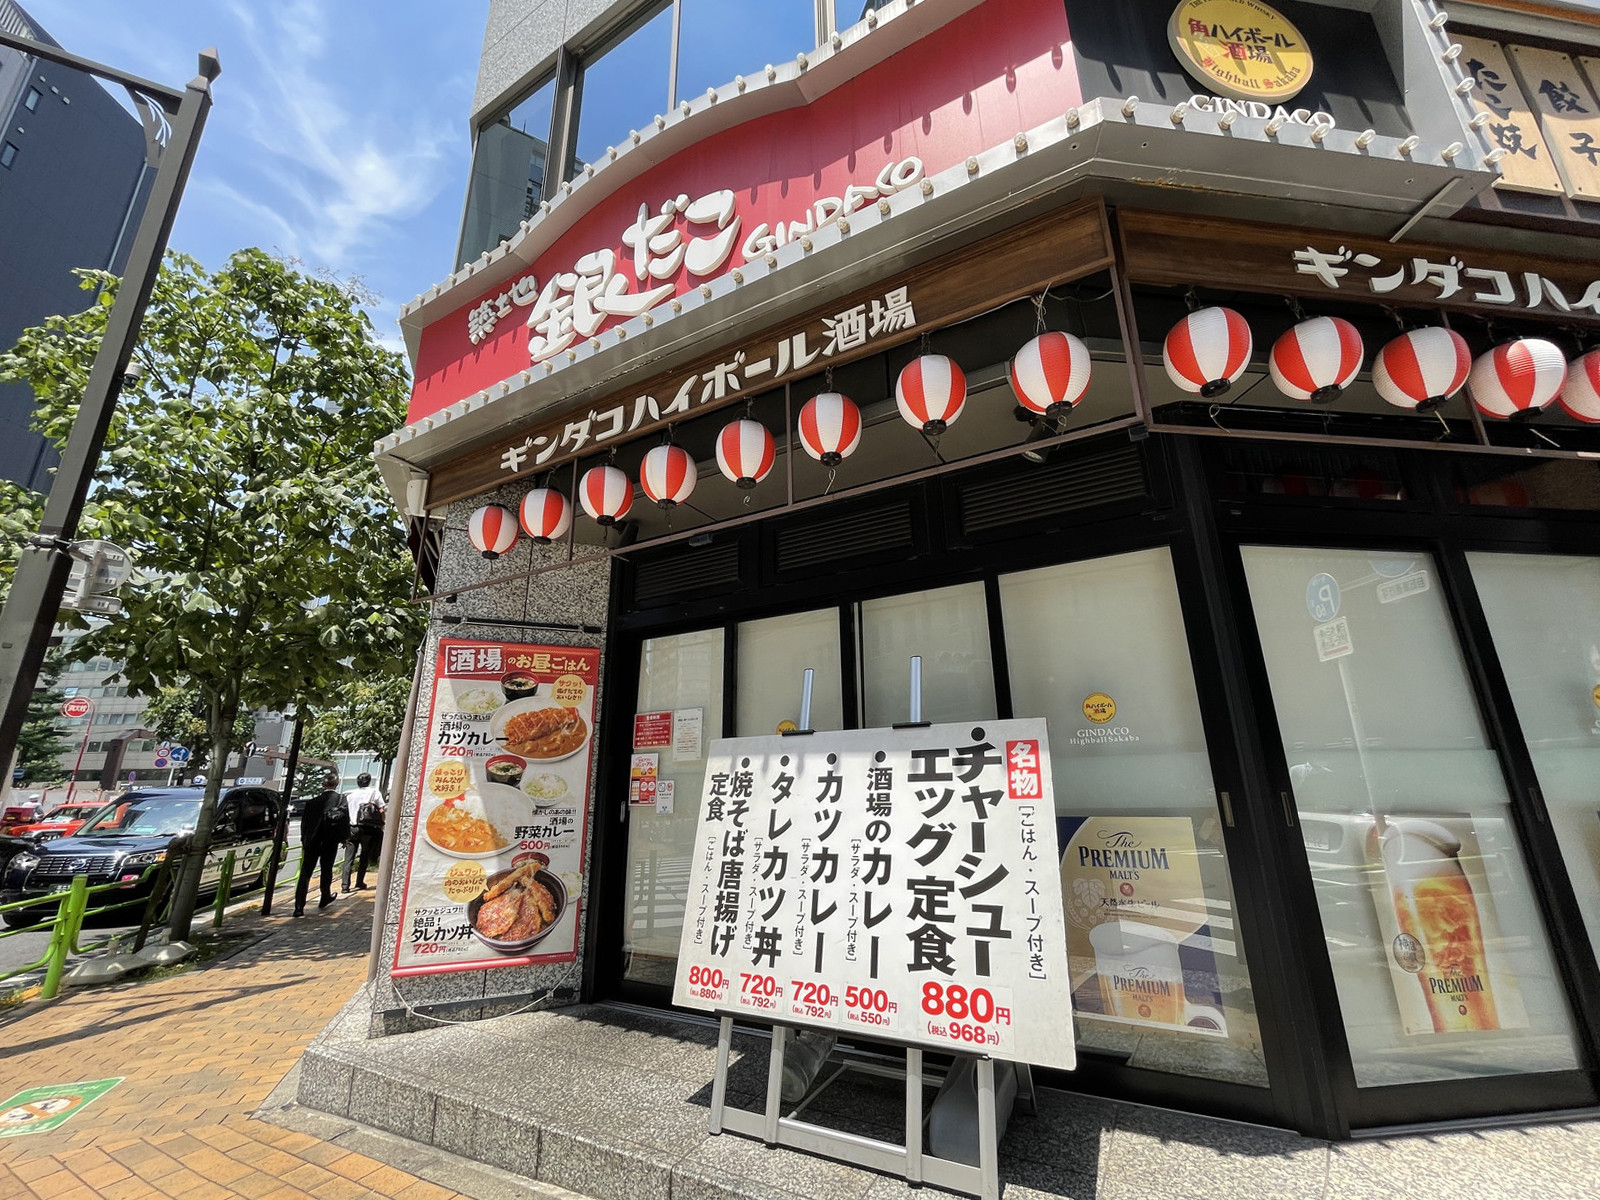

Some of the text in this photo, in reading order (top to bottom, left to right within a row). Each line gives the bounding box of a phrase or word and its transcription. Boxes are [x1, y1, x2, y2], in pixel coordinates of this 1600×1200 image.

[1188, 18, 1296, 48] 角ハイボール
[1218, 39, 1274, 64] 酒場
[1202, 57, 1301, 89] Highball Sakaba
[1187, 94, 1336, 129] GINDACO
[1466, 58, 1538, 160] たこ焼
[527, 189, 742, 363] 銀だこ
[500, 285, 917, 473] ギンダコハイボール酒場
[450, 648, 590, 673] 酒場のお昼ごはん
[438, 731, 510, 746] カツカレー
[440, 721, 470, 731] 酒場の
[1076, 726, 1129, 738] GINDACO
[441, 746, 474, 757] 720円
[1009, 743, 1038, 796] 名物
[705, 772, 730, 822] 定食
[514, 826, 574, 839] 野菜カレー
[549, 817, 573, 825] 酒場の
[520, 840, 550, 850] 500円
[1097, 830, 1142, 848] The
[710, 771, 753, 958] 焼そば唐揚げ
[751, 771, 796, 968] タレカツ丼
[906, 748, 956, 976] エッグ定食
[951, 742, 1012, 978] チャーシュー
[1078, 845, 1170, 870] PREMIUM
[810, 771, 843, 973] カツカレー
[861, 767, 893, 979] 酒場のカレー
[1109, 870, 1140, 880] MALT'S
[411, 924, 474, 943] タレカツ丼
[413, 917, 441, 928] 絶品!
[413, 942, 447, 954] 720円
[689, 965, 729, 990] 800円
[740, 973, 783, 998] 720円
[1113, 975, 1171, 997] PREMIUM
[1429, 974, 1484, 994] PREMIUM
[791, 980, 839, 1007] 720円
[845, 985, 897, 1013] 500円
[921, 981, 1011, 1026] 880円
